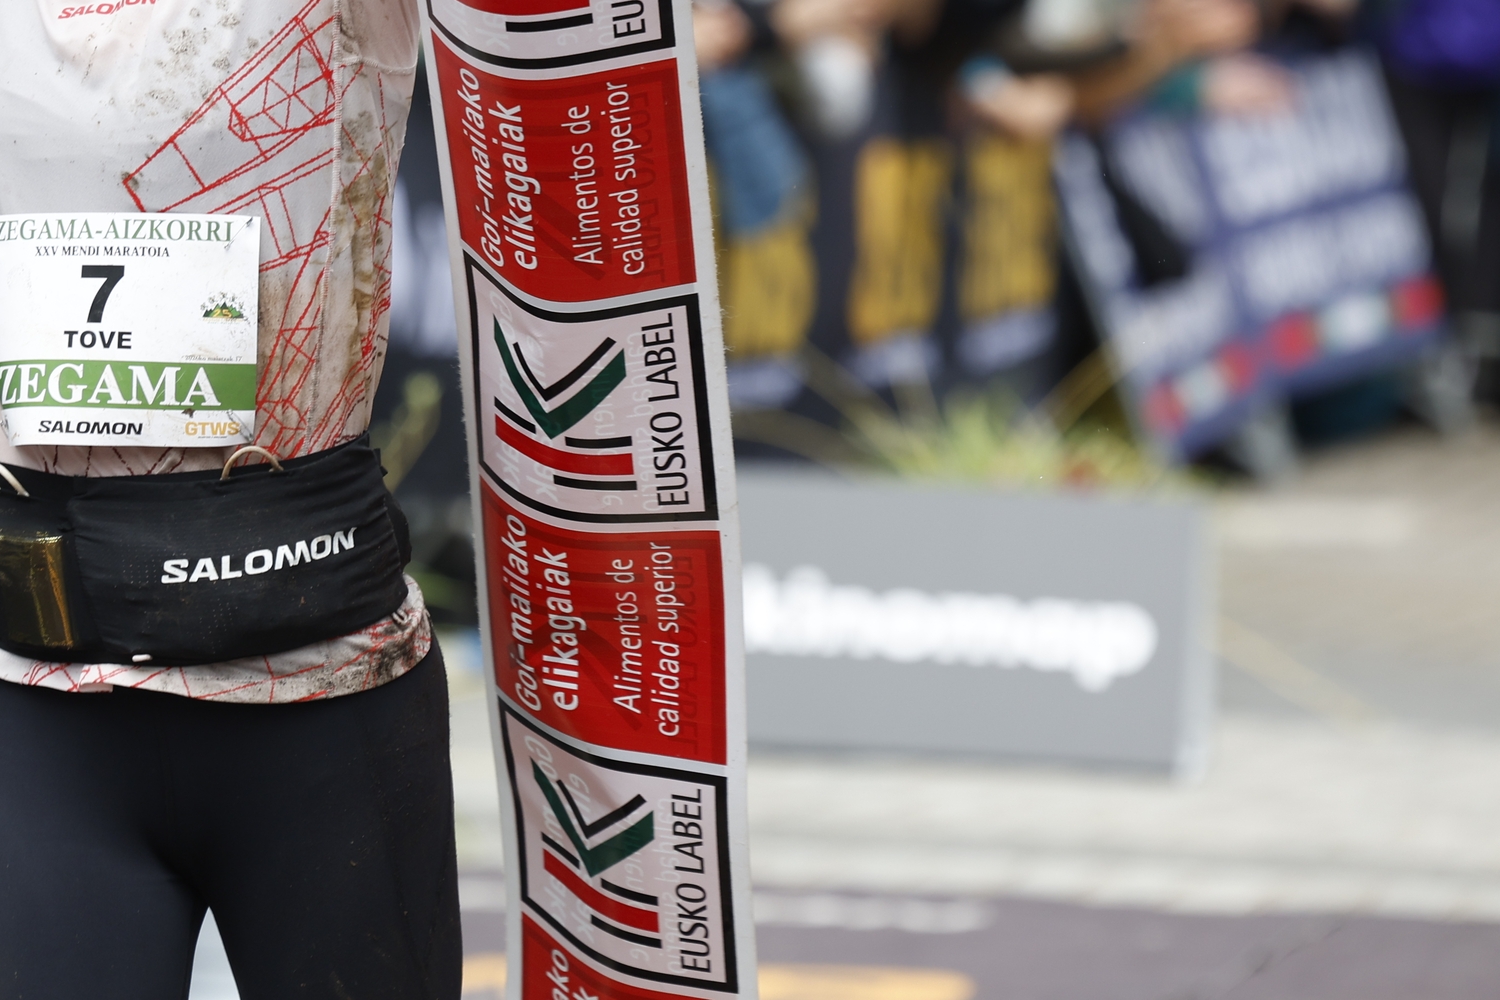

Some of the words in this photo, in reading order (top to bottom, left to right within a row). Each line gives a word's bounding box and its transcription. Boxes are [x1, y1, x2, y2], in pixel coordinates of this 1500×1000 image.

[561, 105, 591, 135] de
[600, 82, 642, 182] superior
[457, 68, 504, 268] Goi-mailako
[488, 101, 541, 270] elikagaiak
[569, 142, 604, 264] Alimentos
[35, 246, 59, 257] XXV
[61, 246, 100, 257] MENDI
[103, 246, 170, 257] MARATOIA
[609, 189, 645, 276] calidad
[81, 264, 125, 323] 7
[0, 363, 221, 406] ZEGAMA
[64, 330, 132, 349] TOVE
[641, 313, 680, 403] LABEL
[38, 420, 143, 436] SALOMON
[185, 421, 240, 436] GTWS
[650, 411, 690, 506] EUSKO
[161, 527, 358, 584] SALOMON
[605, 558, 633, 584] de
[644, 542, 685, 633] superior
[501, 514, 542, 712] Goi-mailako
[534, 547, 586, 711] elikagaiak
[612, 591, 641, 714] Alimentos
[651, 640, 680, 736] calidad
[671, 788, 705, 875] LABEL
[675, 883, 712, 973] EUSKO
